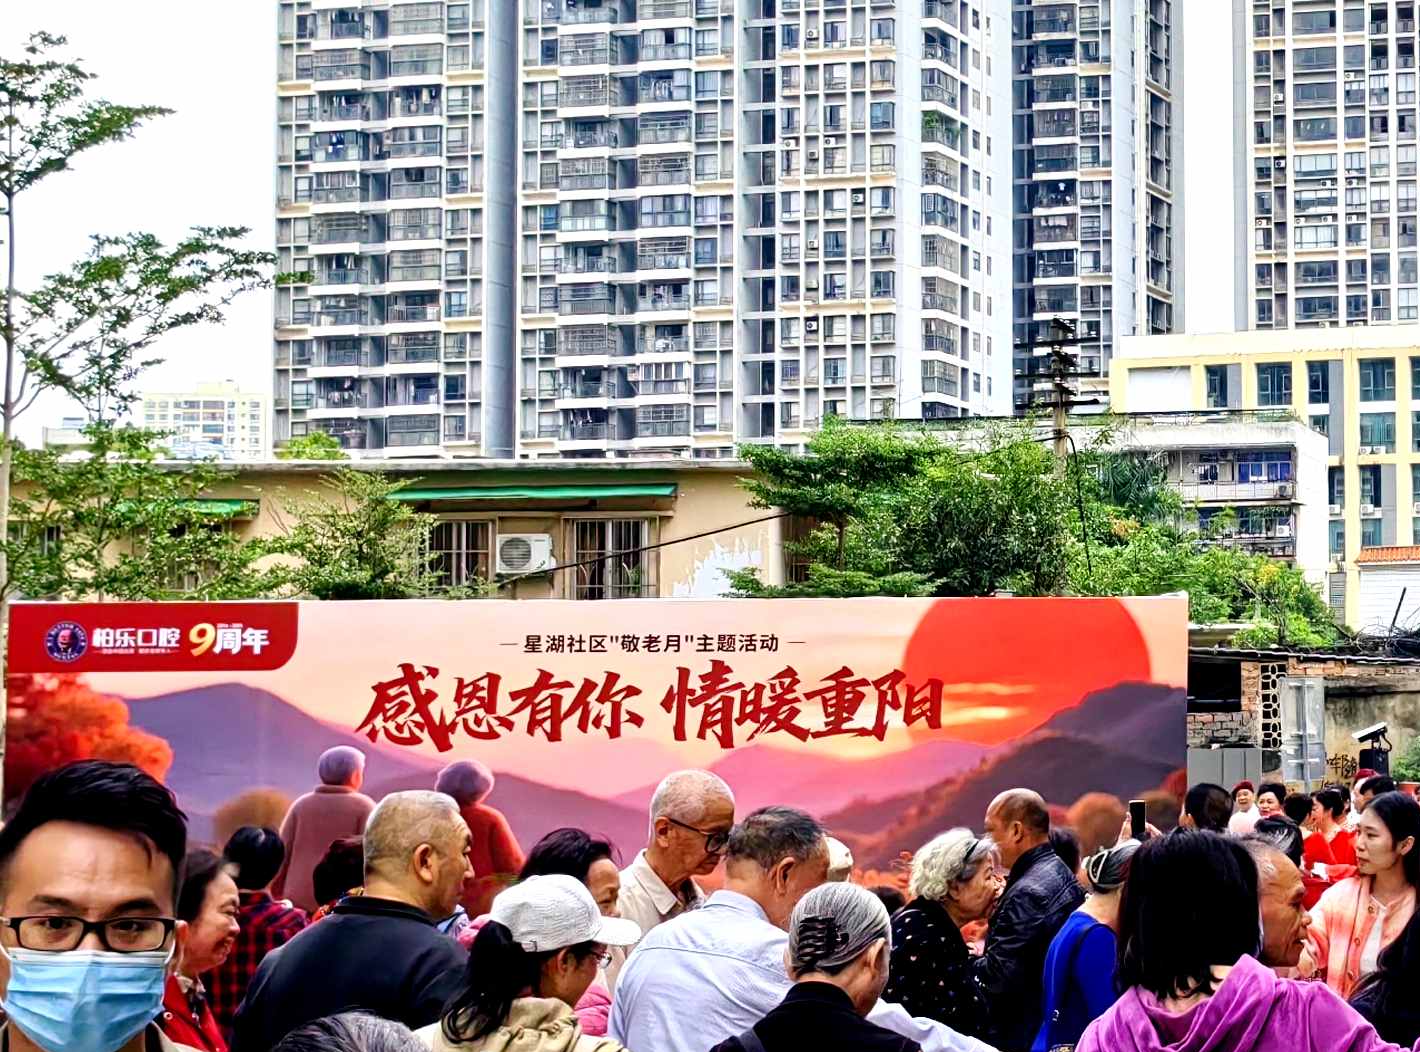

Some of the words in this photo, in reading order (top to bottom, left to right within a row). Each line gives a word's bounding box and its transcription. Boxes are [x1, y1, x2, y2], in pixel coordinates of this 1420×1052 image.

[523, 633, 779, 653] 星湖社区"敬老月"主题活动
[355, 663, 645, 753] 感恩有你
[660, 660, 944, 749] 情暖重阳
